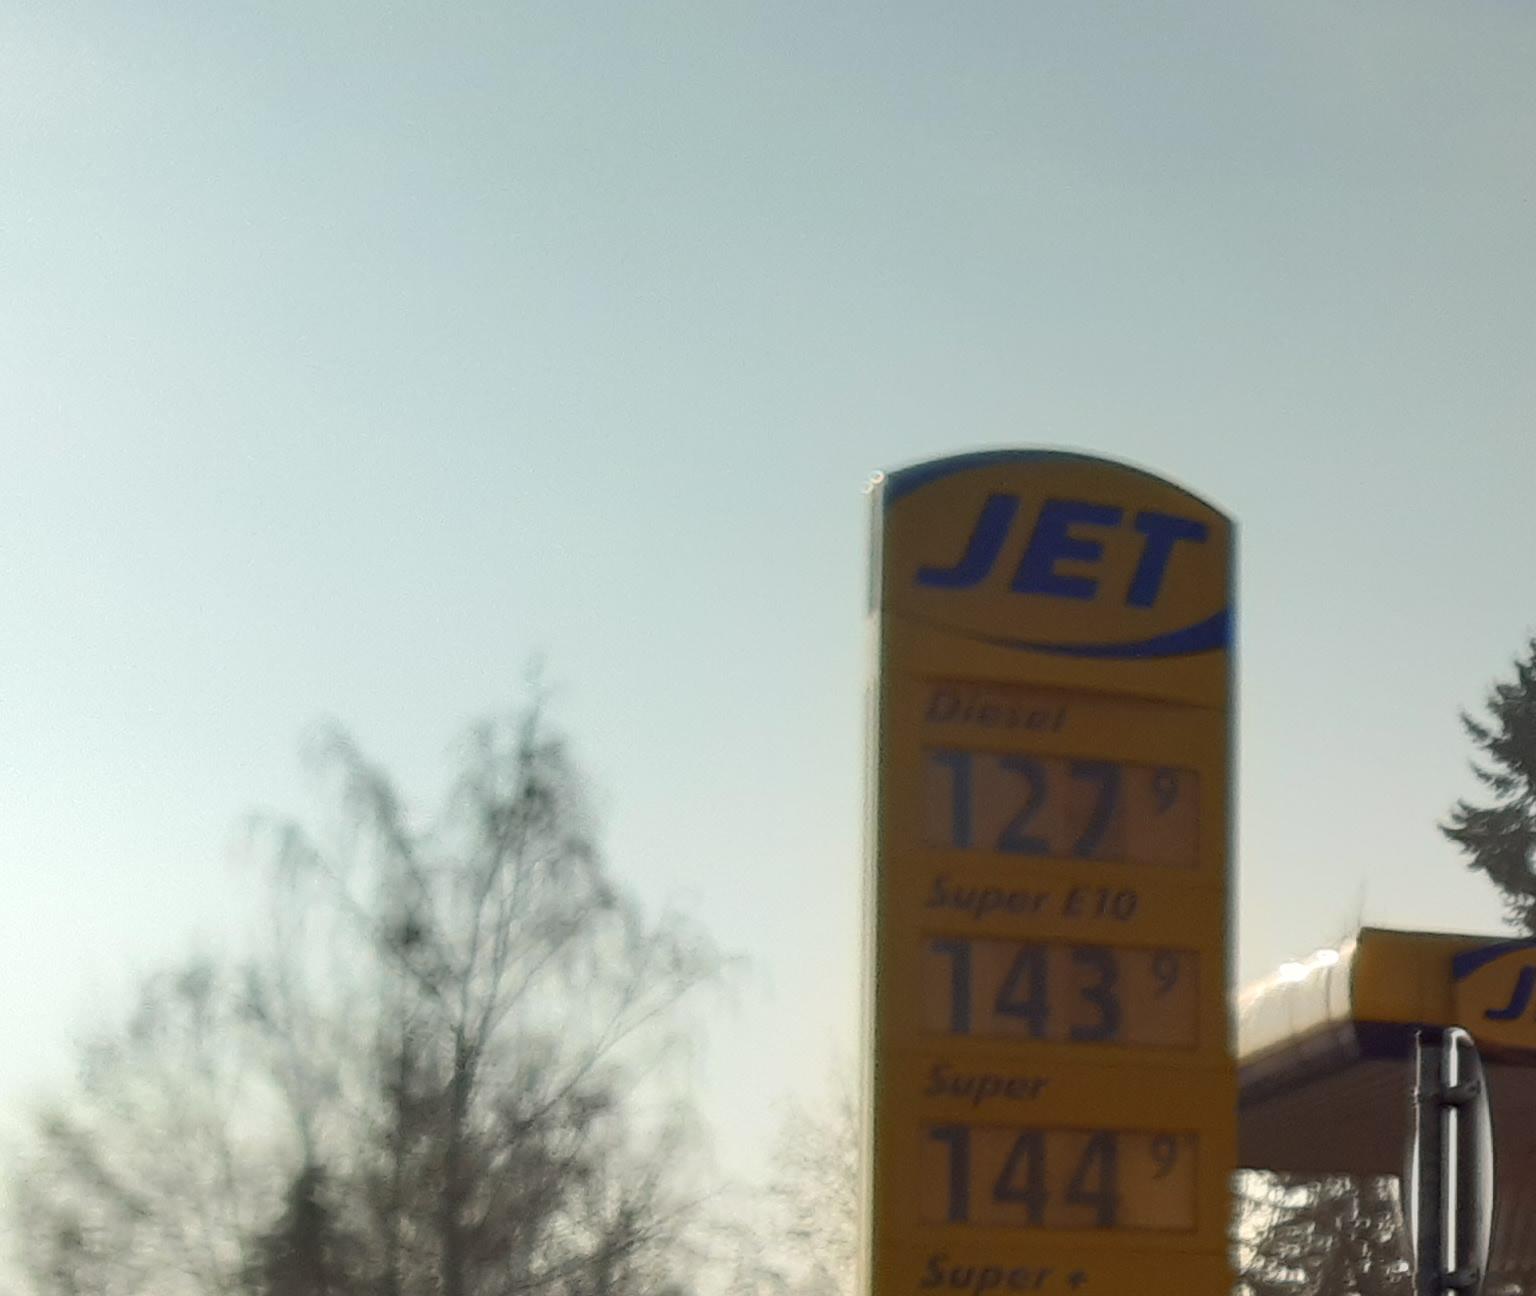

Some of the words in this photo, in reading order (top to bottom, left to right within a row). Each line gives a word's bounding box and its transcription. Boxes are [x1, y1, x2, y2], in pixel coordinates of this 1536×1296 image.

[915, 492, 1210, 611] JET
[925, 691, 1068, 733] Diesel
[926, 873, 1049, 919] Super
[1063, 886, 1138, 920] E10
[923, 1063, 1049, 1107] Super
